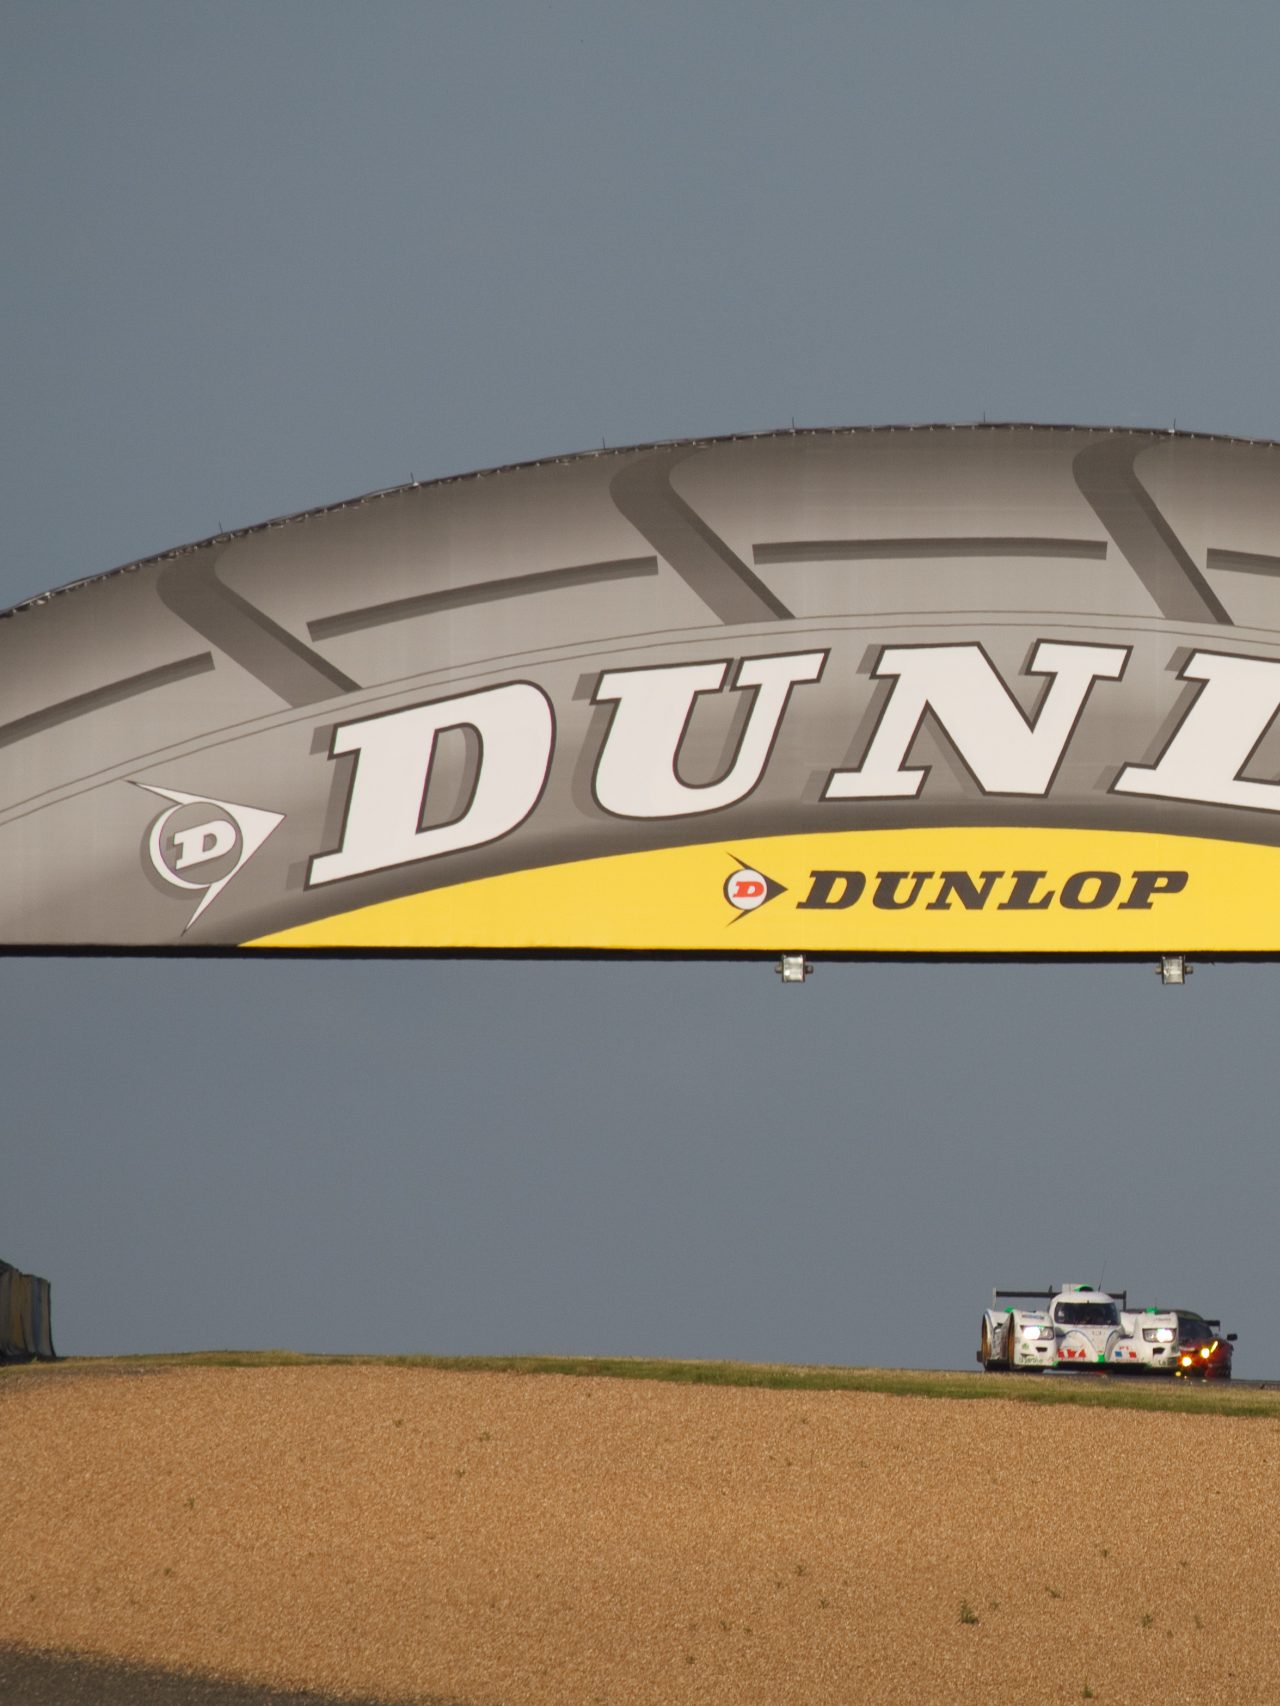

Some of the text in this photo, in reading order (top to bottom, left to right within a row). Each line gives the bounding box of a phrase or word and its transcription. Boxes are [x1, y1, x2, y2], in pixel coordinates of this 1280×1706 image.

[173, 820, 237, 870] D
[732, 880, 765, 898] D
[796, 870, 1189, 910] DUNLOP
